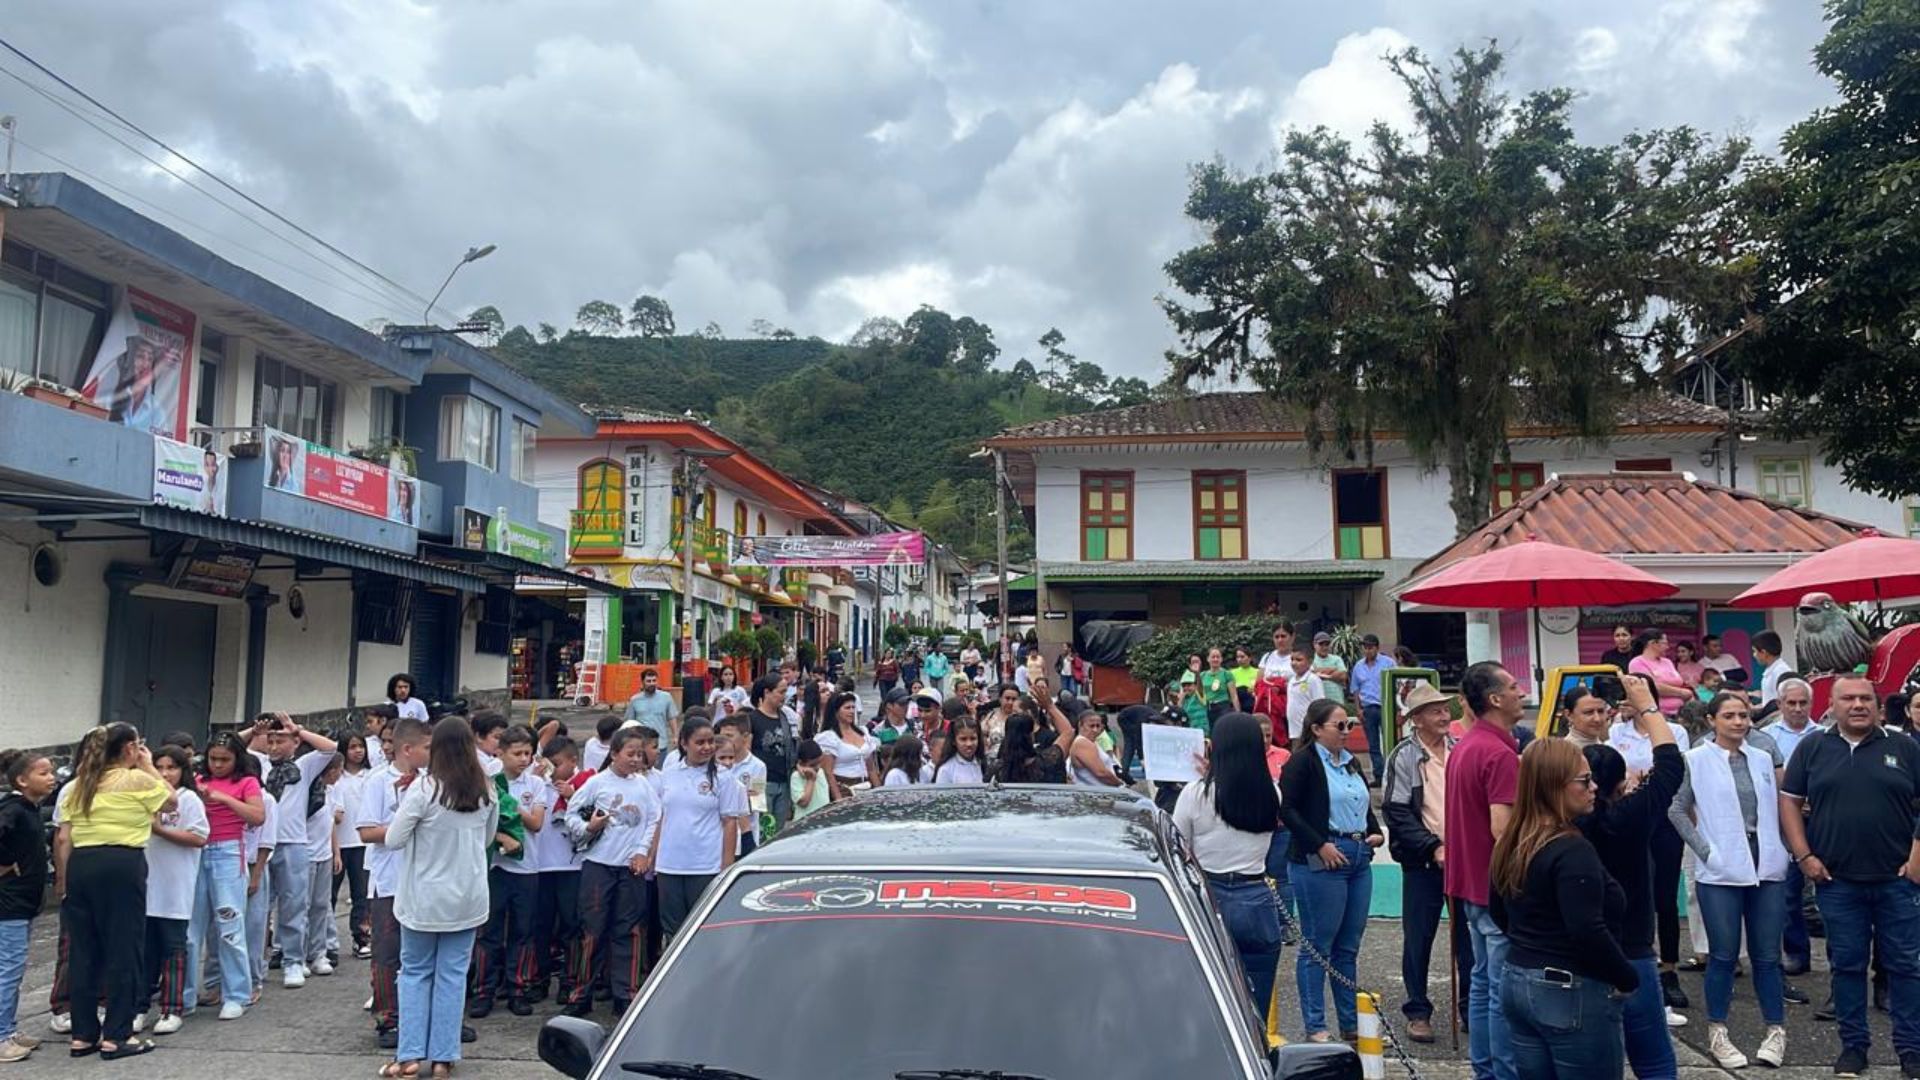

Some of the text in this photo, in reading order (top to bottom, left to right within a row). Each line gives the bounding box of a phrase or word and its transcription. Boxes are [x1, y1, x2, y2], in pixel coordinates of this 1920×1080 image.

[158, 471, 203, 489] Marulanda
[629, 456, 641, 543] HOTEL
[875, 902, 1136, 920] TEAM RACING
